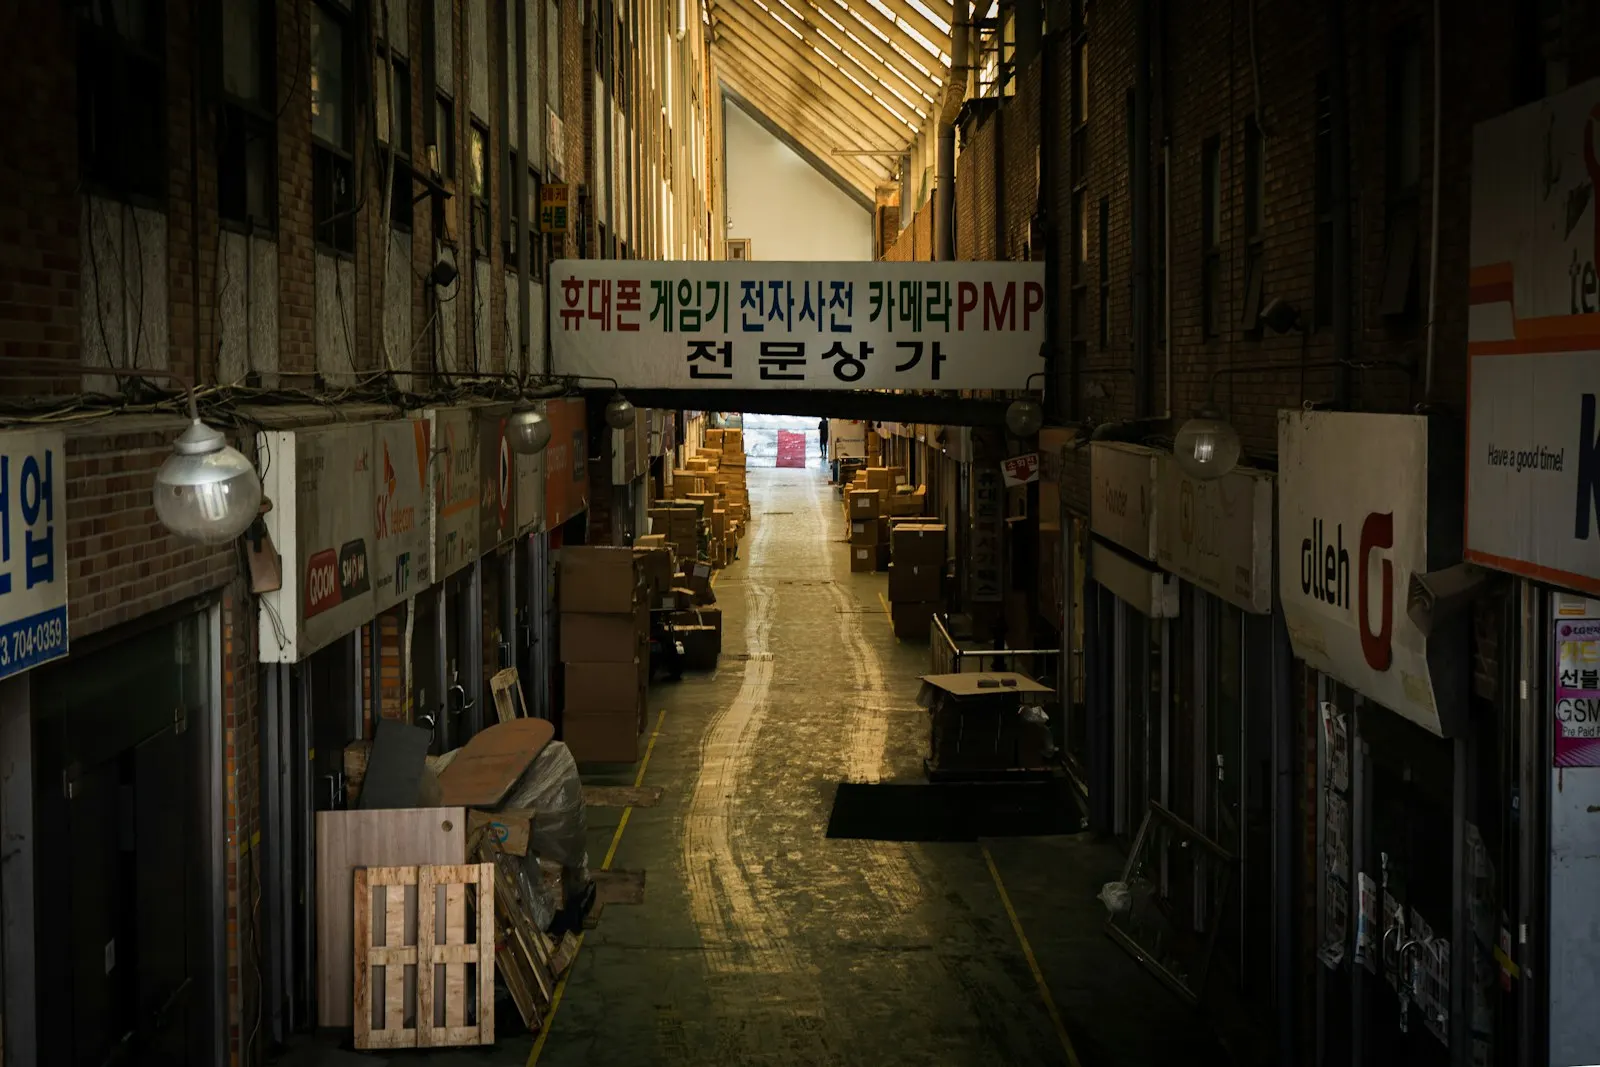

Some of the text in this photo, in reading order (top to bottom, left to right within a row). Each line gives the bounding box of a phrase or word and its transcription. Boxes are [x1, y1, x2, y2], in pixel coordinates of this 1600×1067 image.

[1568, 248, 1600, 315] te
[560, 275, 1044, 333] 휴대폰 게임기 전자사전 카메라 PMP
[687, 340, 946, 381] 전문상가
[1488, 444, 1564, 473] Have a good time!
[375, 493, 415, 541] SK telecom
[342, 553, 365, 588] SHOW
[1301, 517, 1350, 610] olleh
[12, 616, 62, 662] 704-0359
[1560, 668, 1600, 689] 선불
[1558, 698, 1600, 723] GSM
[1563, 726, 1576, 737] Pre
[1577, 726, 1595, 737] Paid
